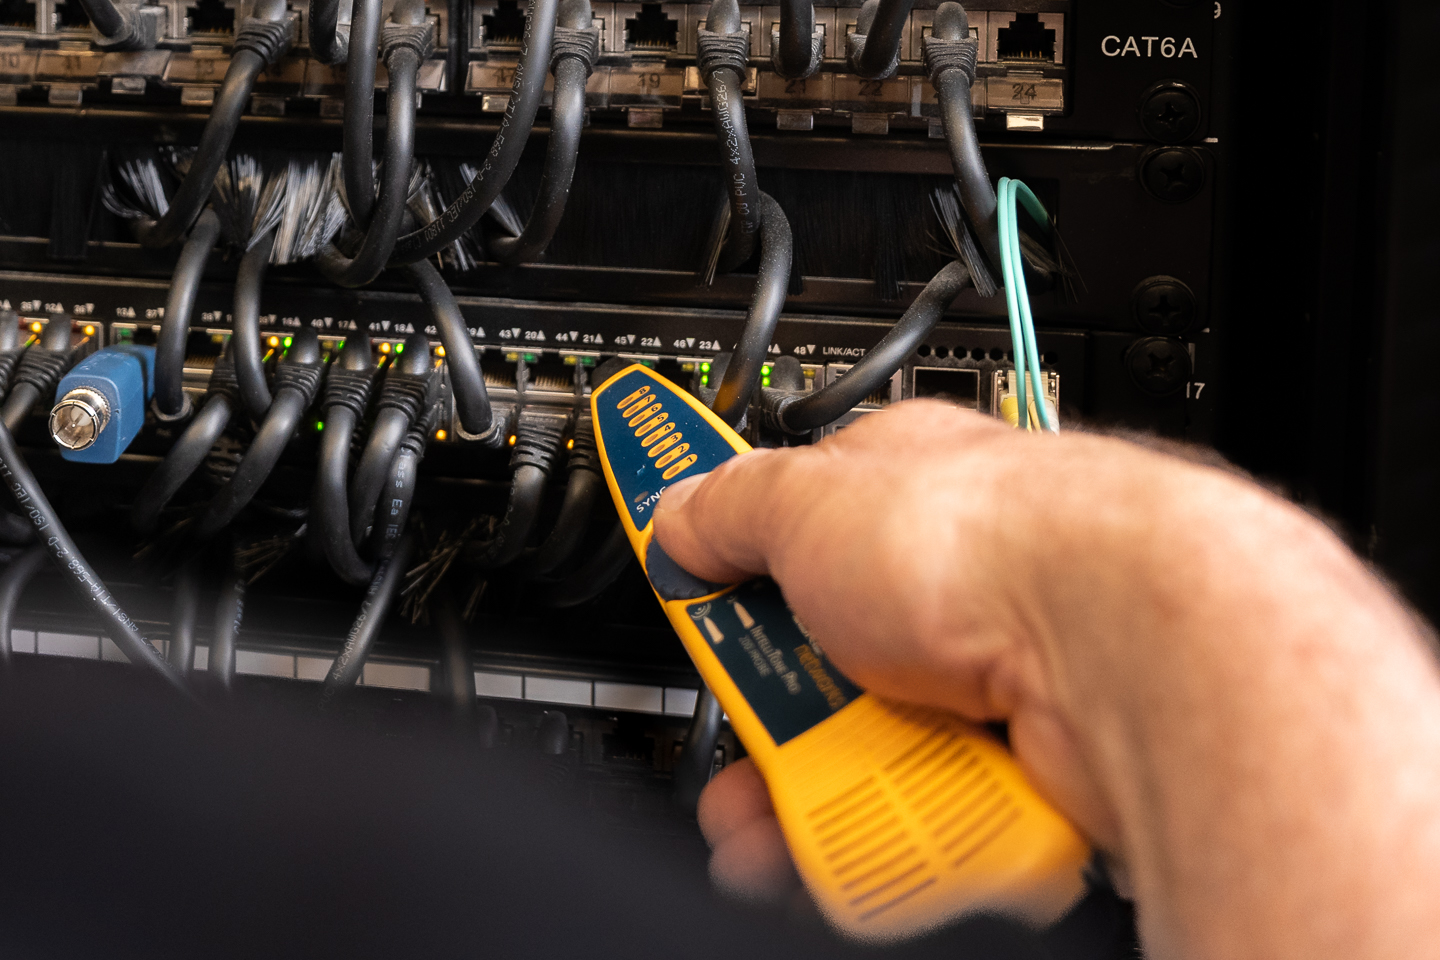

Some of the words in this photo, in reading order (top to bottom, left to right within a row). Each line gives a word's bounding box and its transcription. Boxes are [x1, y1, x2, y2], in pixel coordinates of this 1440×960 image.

[1100, 35, 1198, 58] CAT6A
[499, 328, 511, 338] 43
[555, 331, 568, 341] 44
[583, 333, 595, 343] 21
[615, 335, 627, 345] 45
[641, 336, 653, 346] 22
[673, 338, 686, 348] 46
[699, 340, 712, 349] 23
[794, 345, 806, 354] 48
[822, 346, 865, 357] LINK/ACT
[390, 497, 403, 515] Ea
